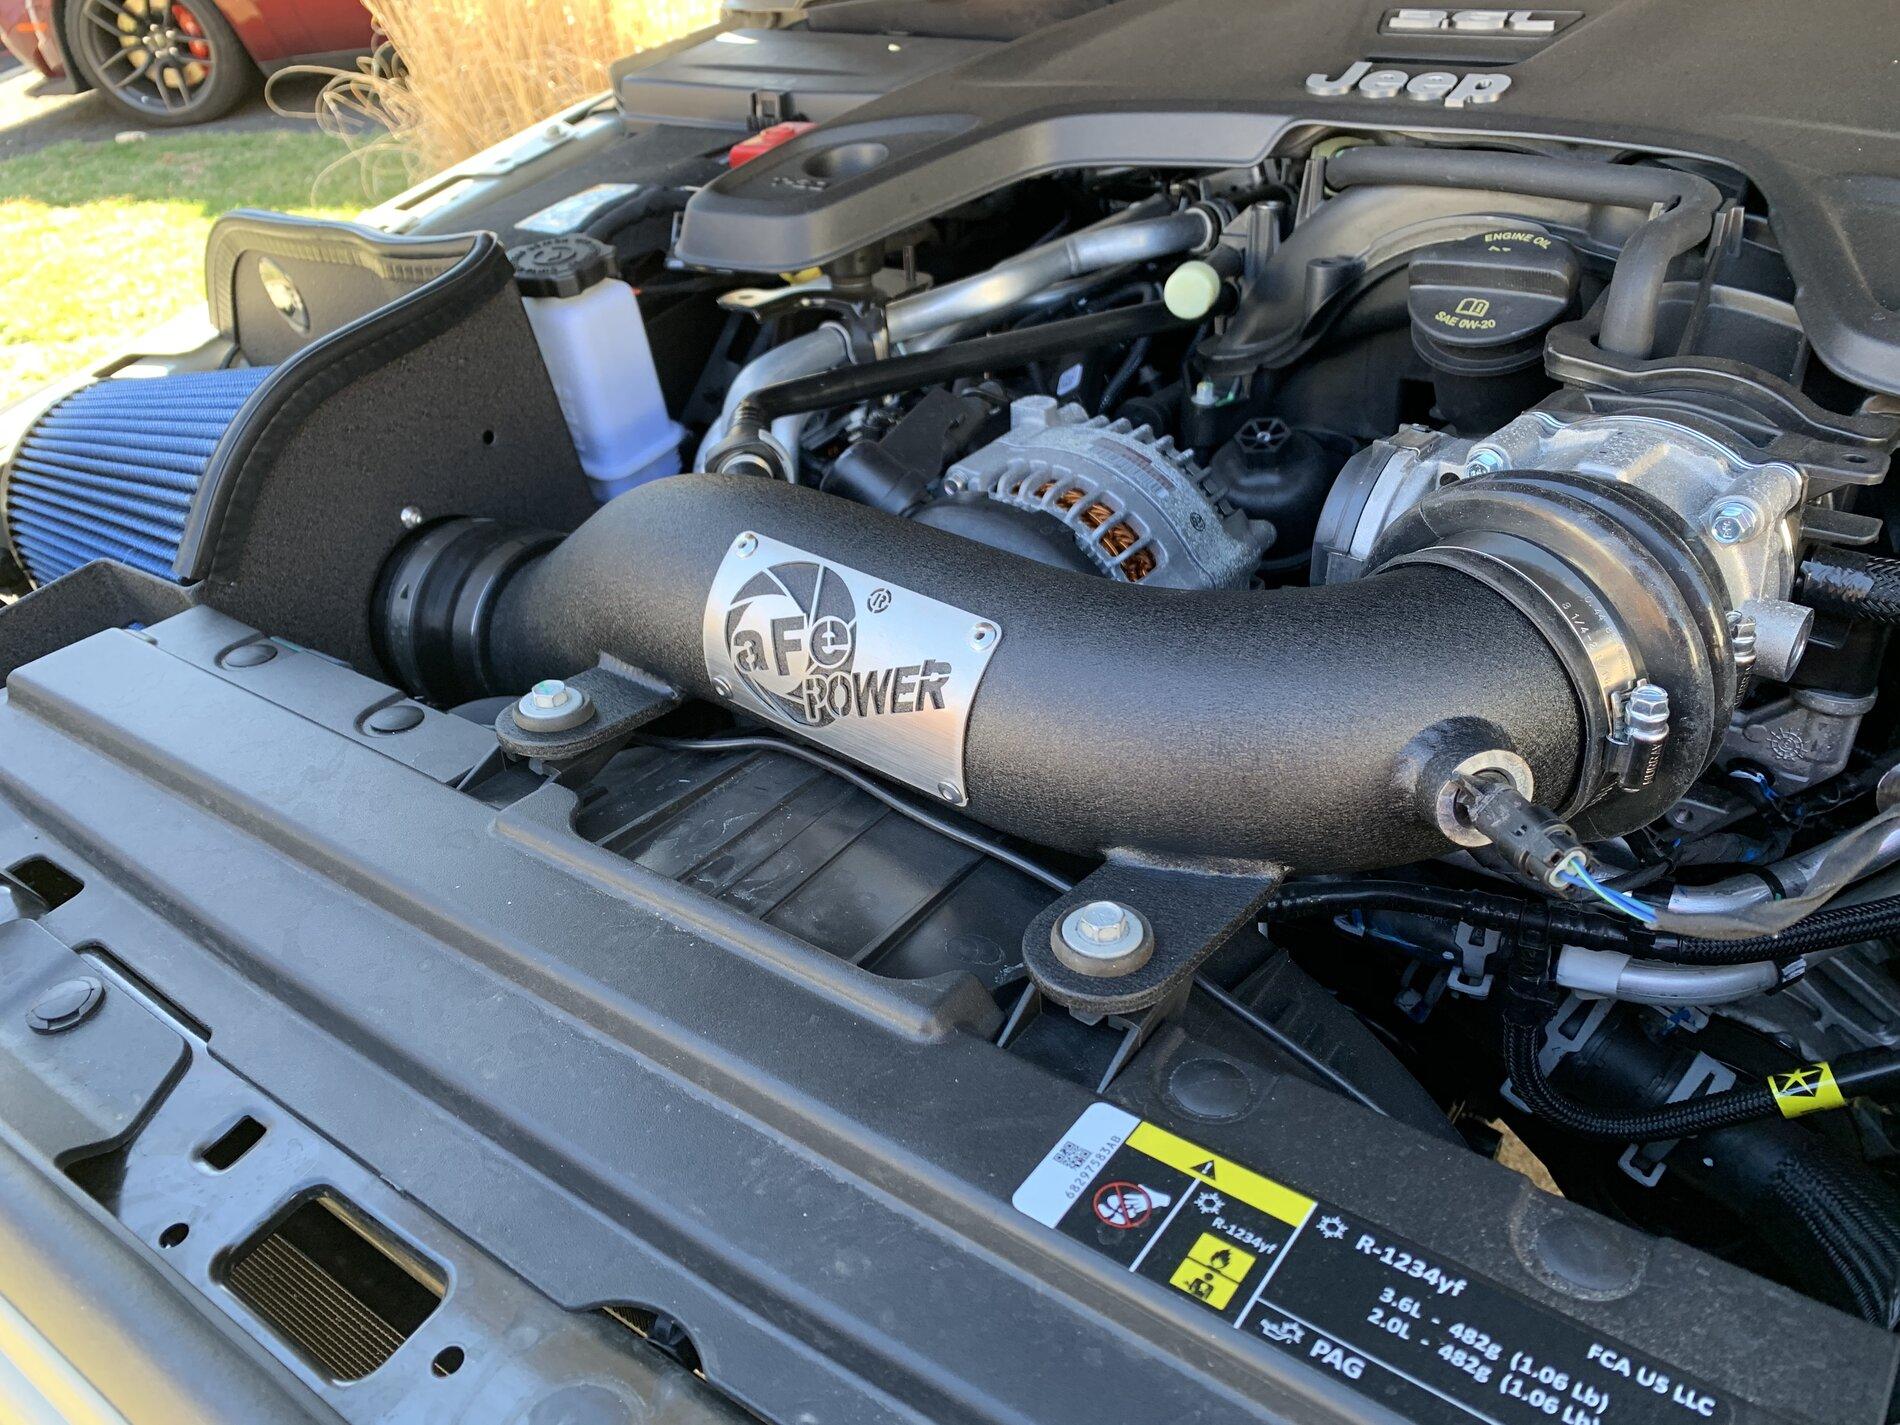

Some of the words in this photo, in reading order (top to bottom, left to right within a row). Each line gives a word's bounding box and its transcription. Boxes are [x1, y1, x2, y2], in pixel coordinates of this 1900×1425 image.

[1305, 61, 1512, 108] Jeep
[1484, 232, 1534, 242] ENGINE
[1533, 236, 1551, 249] OIL
[1435, 311, 1459, 326] SAE
[1458, 319, 1496, 329] 0W-20
[731, 613, 850, 676] aFe
[802, 659, 952, 722] POWER
[1065, 1135, 1122, 1199] 68297583AB
[1211, 1216, 1279, 1255] R-1234yf
[1355, 1234, 1468, 1297] R-1234yf
[1309, 1339, 1366, 1379] PAG
[1367, 1307, 1410, 1341] 2.0L
[1437, 1344, 1493, 1384] 482g
[1500, 1373, 1560, 1415] (1.06
[1378, 1286, 1421, 1319] 3.6L
[1448, 1322, 1503, 1361] 482g
[1510, 1351, 1570, 1392] (1.06
[1571, 1381, 1609, 1414] Lb)
[1586, 1343, 1631, 1378] FCA
[1636, 1366, 1670, 1394] US
[1673, 1384, 1716, 1417] LLC
